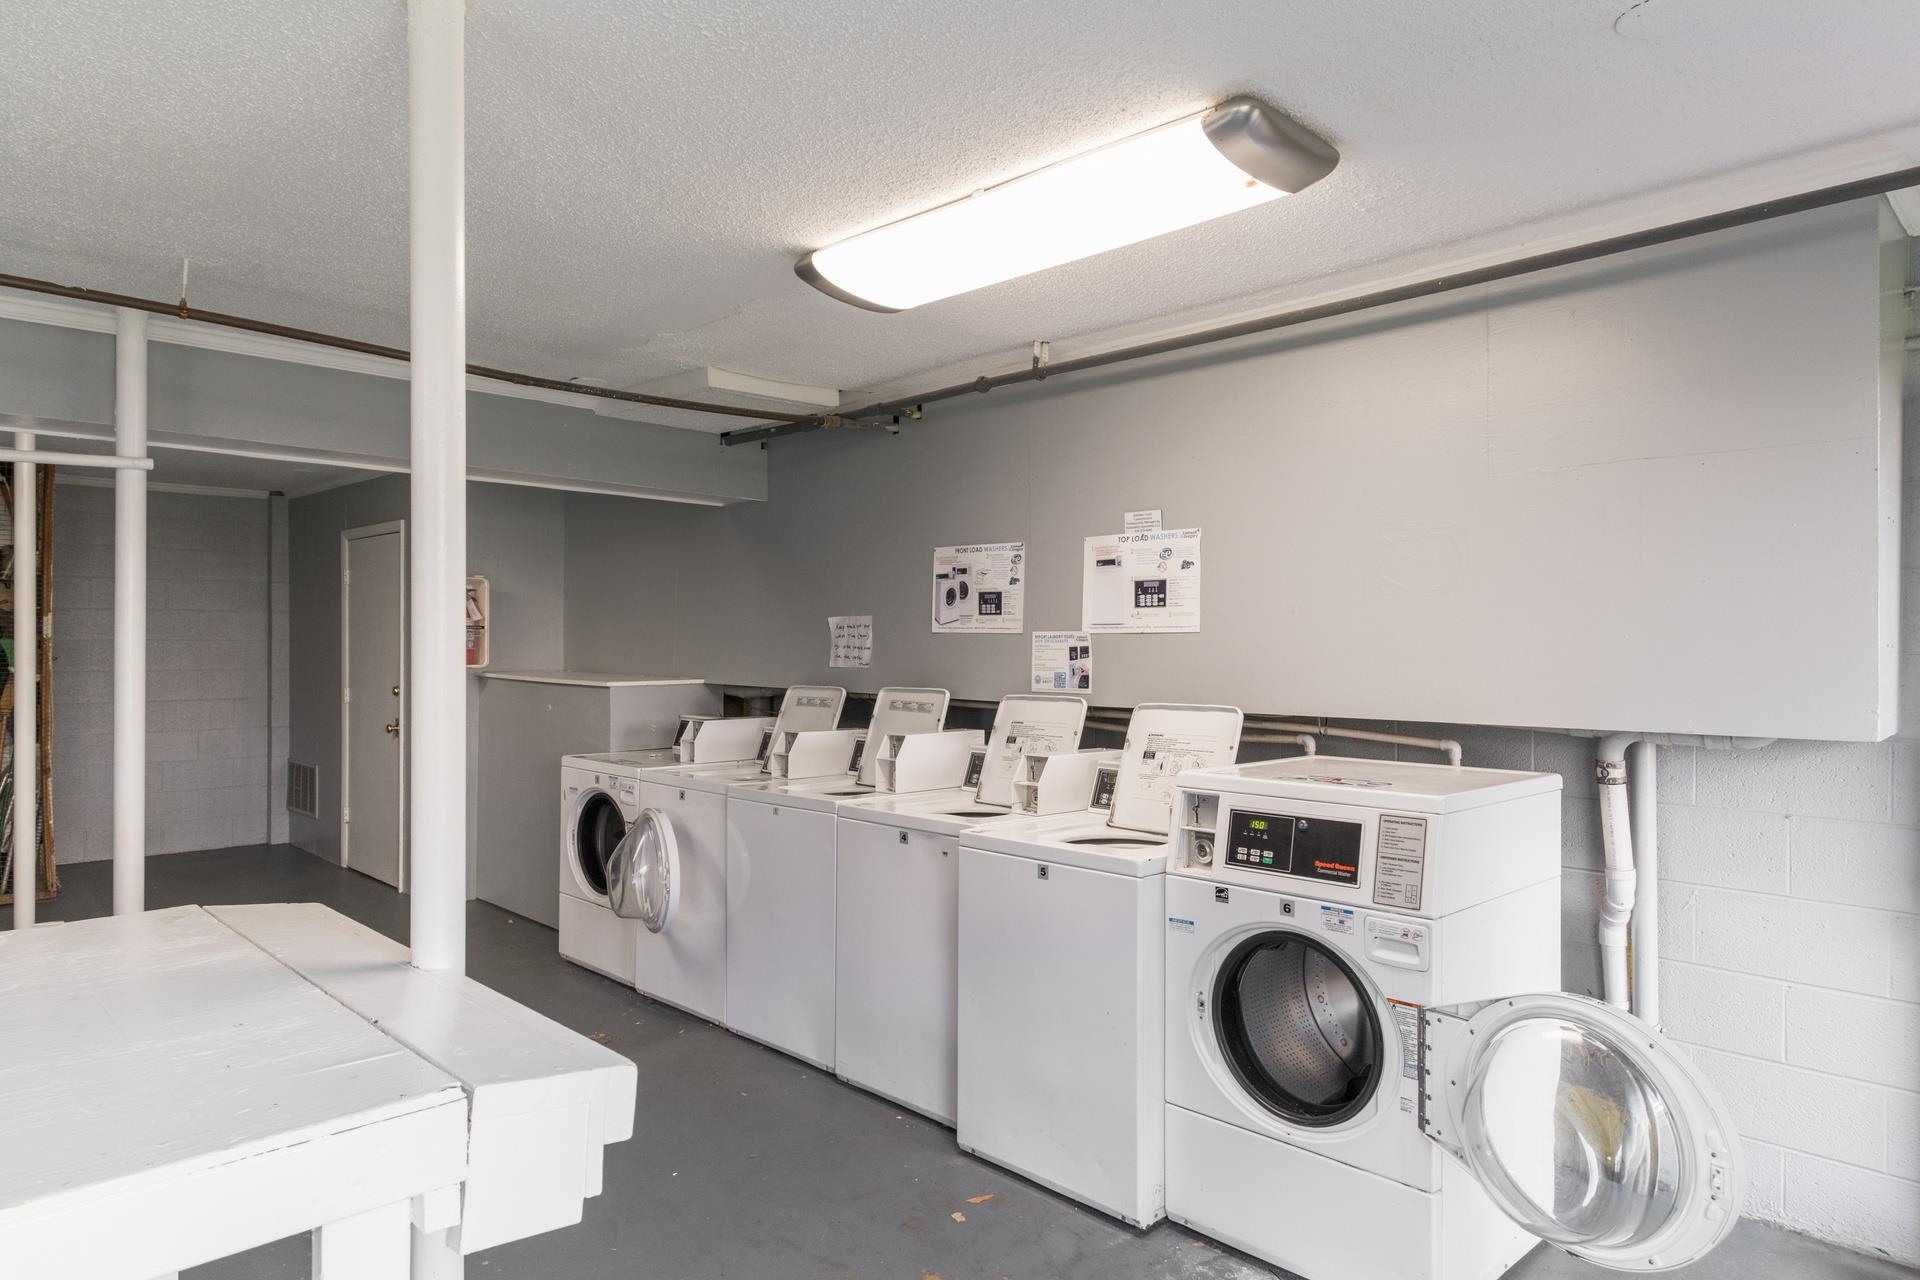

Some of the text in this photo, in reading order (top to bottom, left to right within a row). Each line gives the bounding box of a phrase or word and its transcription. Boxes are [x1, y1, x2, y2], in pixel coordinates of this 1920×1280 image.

[1132, 534, 1148, 542] LOAD
[1314, 860, 1355, 872] Speed Queen
[1040, 867, 1046, 876] 5
[1283, 903, 1292, 914] 6
